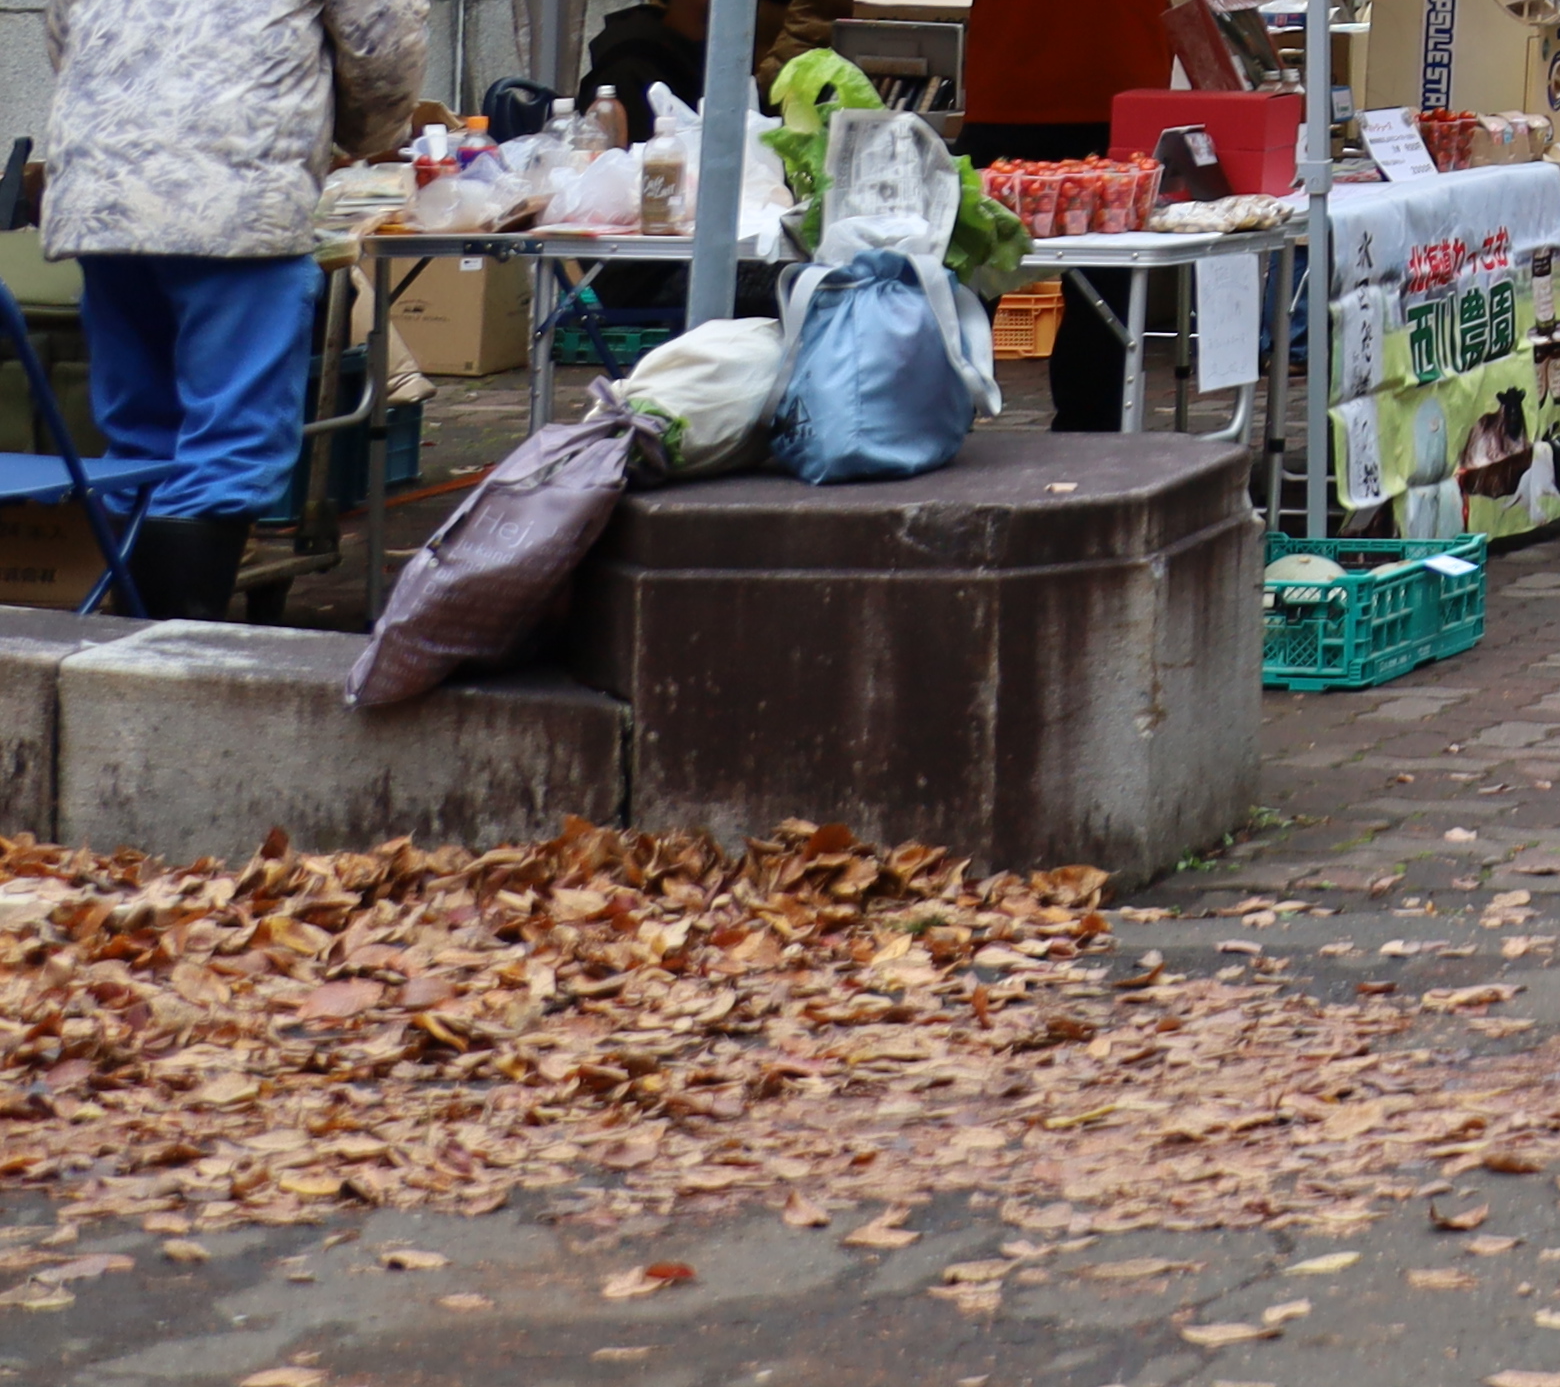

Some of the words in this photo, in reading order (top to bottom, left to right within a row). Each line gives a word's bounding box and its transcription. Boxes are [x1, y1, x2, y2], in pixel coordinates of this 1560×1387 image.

[1406, 278, 1516, 387] 西川農園
[474, 504, 534, 549] Hej,
